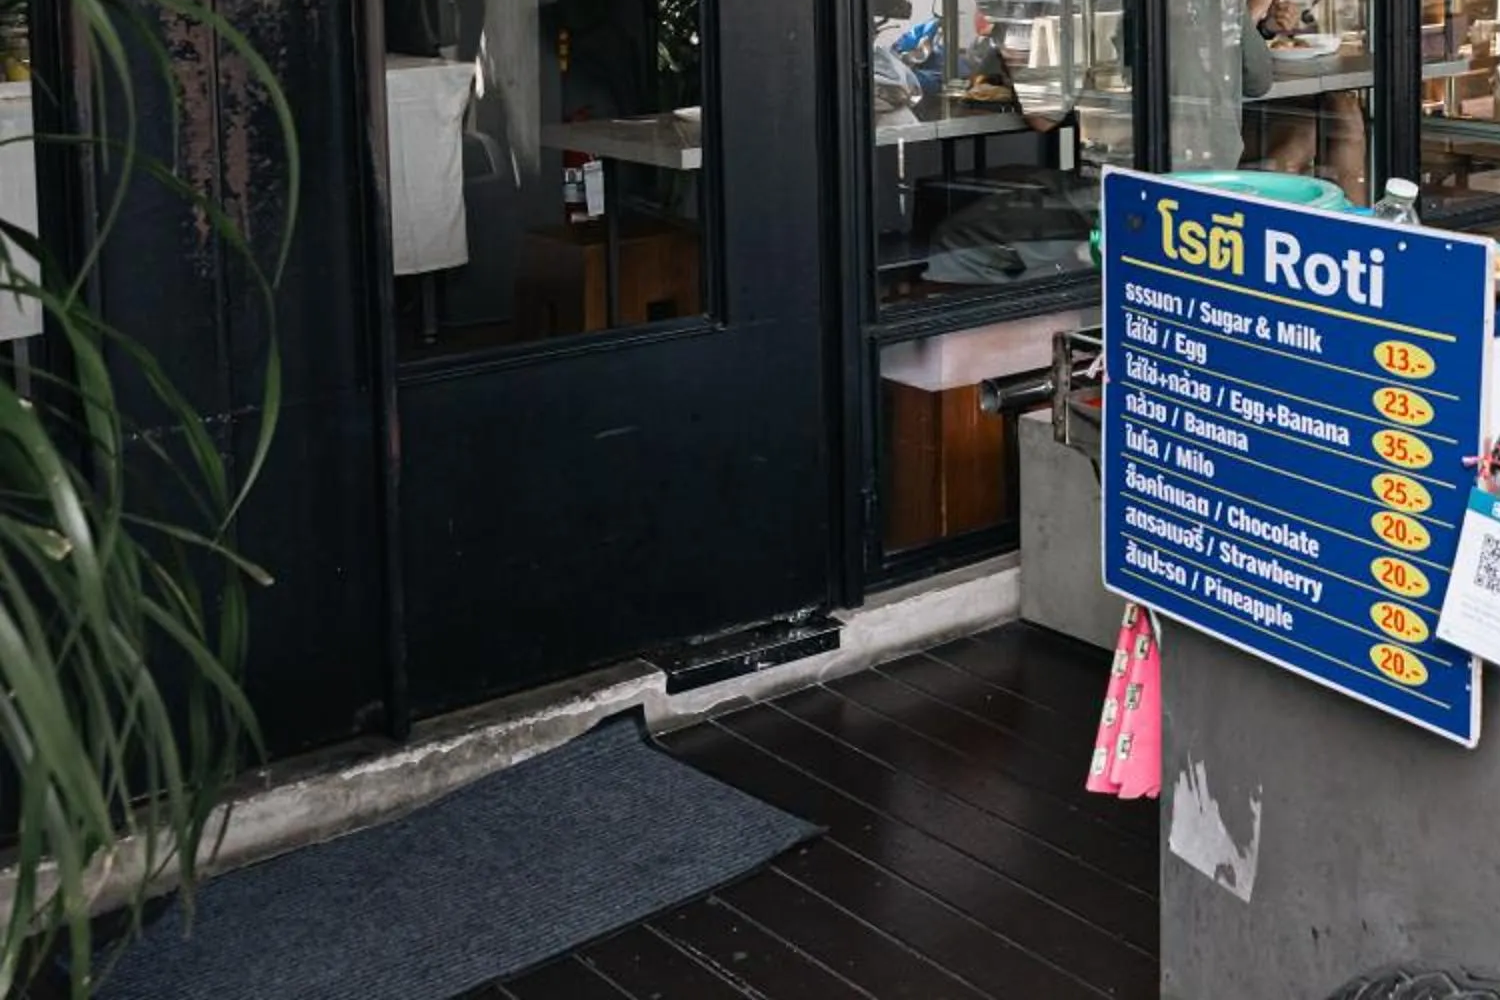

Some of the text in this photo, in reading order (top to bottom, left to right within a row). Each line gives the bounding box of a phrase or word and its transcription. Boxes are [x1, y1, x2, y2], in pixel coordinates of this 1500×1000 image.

[1157, 198, 1384, 309] โรตี Roti
[1125, 283, 1323, 354] ธรรมดา / Sugar & Milk
[1125, 313, 1207, 365] ใส่ไข่ / Egg
[1385, 345, 1426, 373] 13.-
[1126, 390, 1249, 453] กล้วย / Banana
[1216, 386, 1225, 408] /
[1229, 389, 1351, 447] Egg+Banana
[1384, 391, 1425, 420] 23.-
[1125, 423, 1215, 478] ไมโล / Milo
[1383, 434, 1425, 464] 35.-
[1383, 478, 1423, 507] 25.-
[1214, 501, 1222, 522] /
[1227, 505, 1320, 559] Chocolate
[1382, 515, 1423, 545] 20.-
[1206, 536, 1215, 557] /
[1219, 541, 1323, 603] Strawberry
[1381, 560, 1422, 590] 20.-
[1191, 571, 1199, 591] /
[1204, 575, 1294, 631] Pineapple
[1381, 605, 1421, 636] 20.-
[1380, 647, 1421, 678] 20.-
